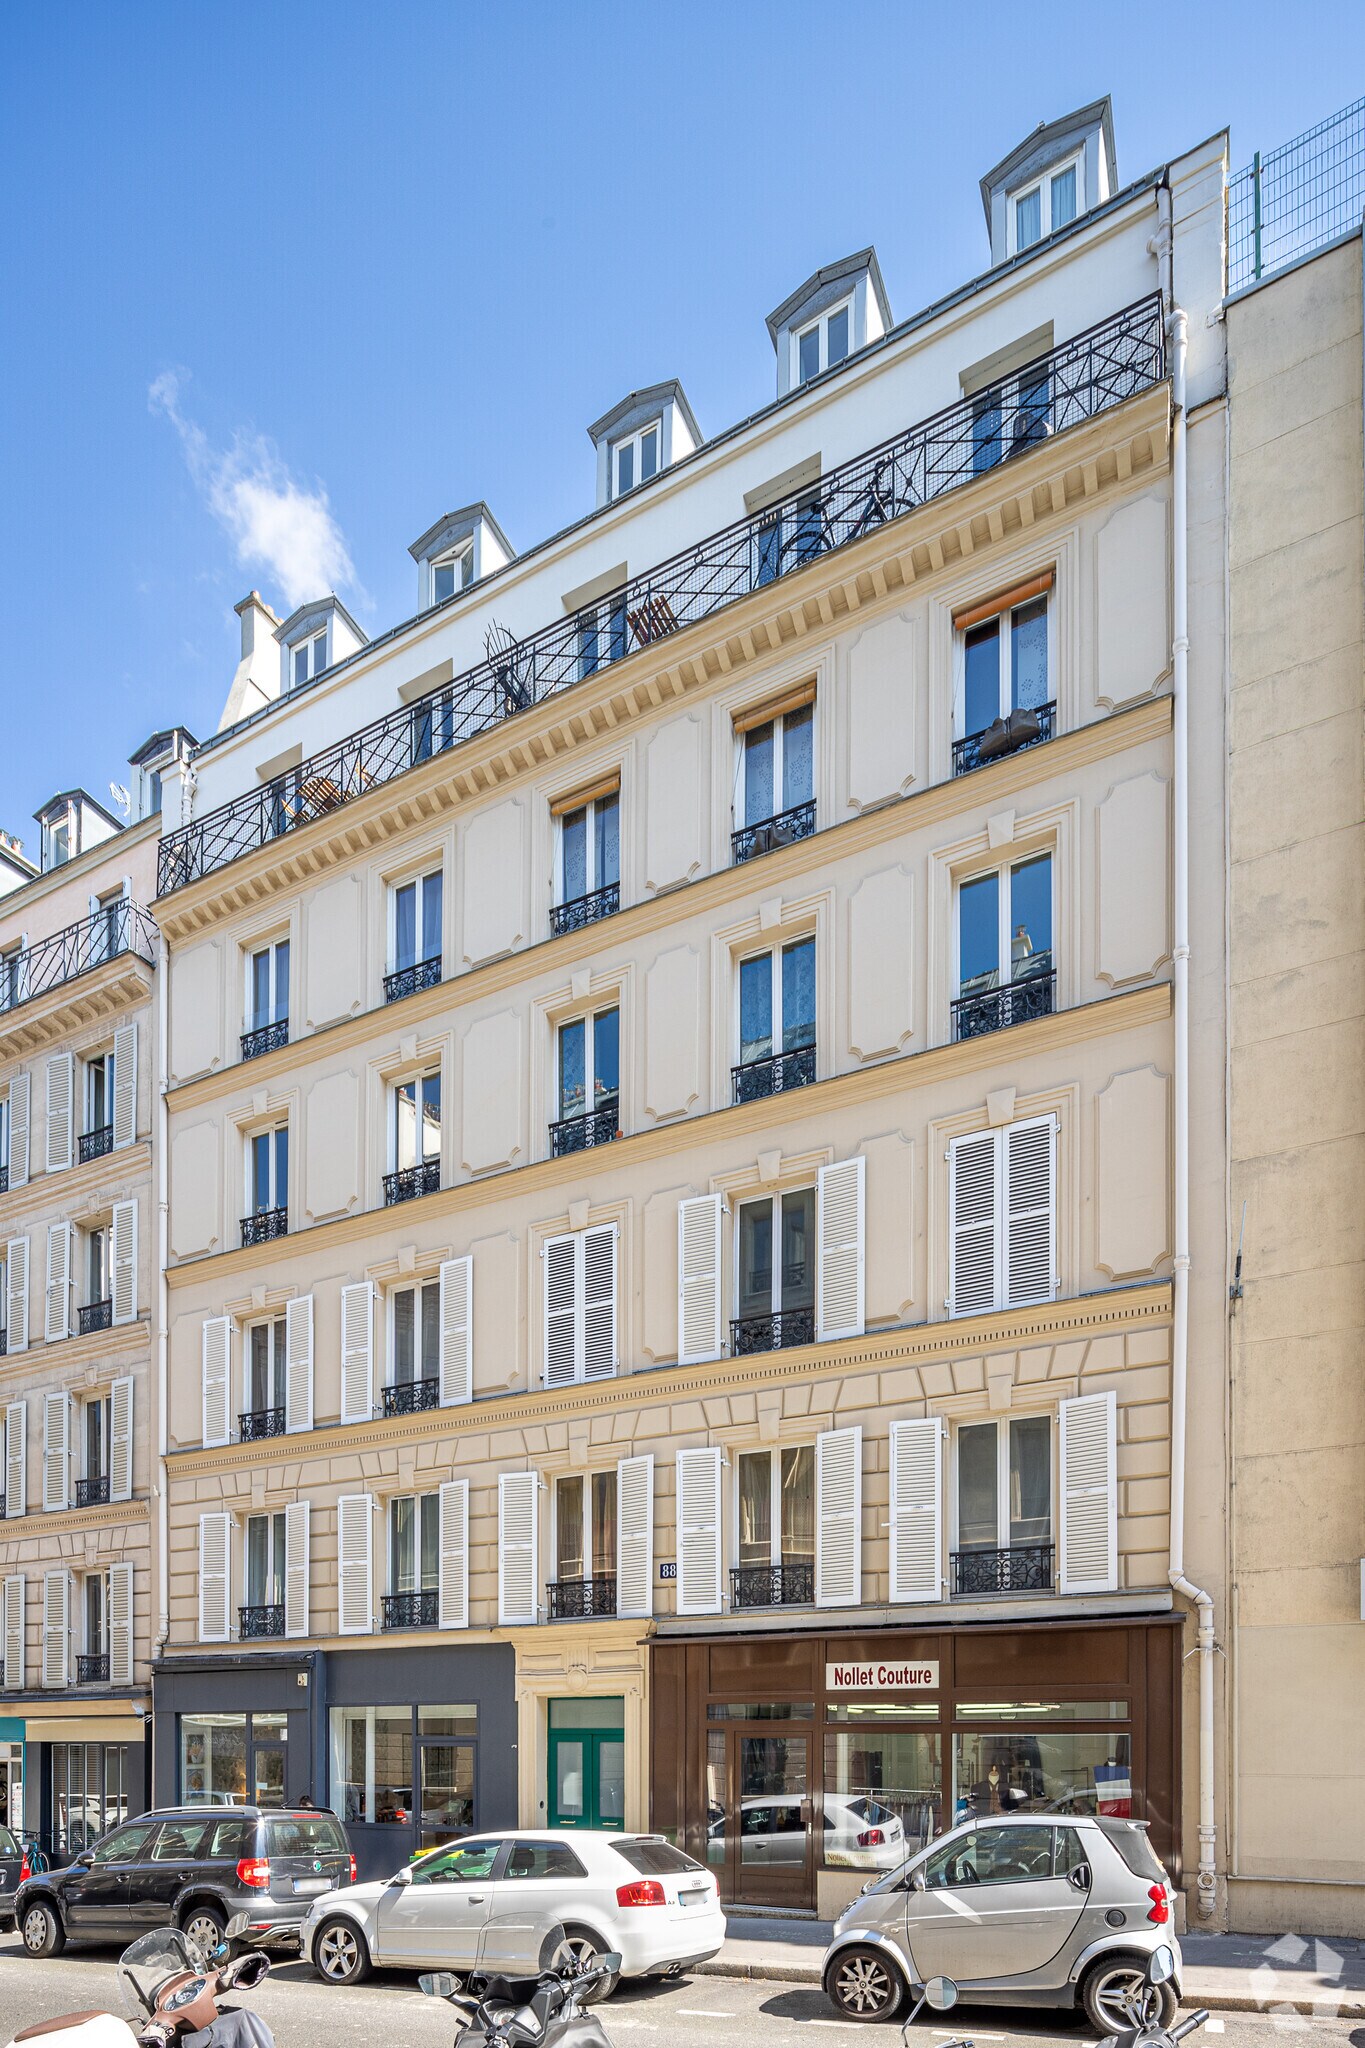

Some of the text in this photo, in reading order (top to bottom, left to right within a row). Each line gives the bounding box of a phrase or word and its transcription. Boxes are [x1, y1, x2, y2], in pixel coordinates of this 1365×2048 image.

[662, 1564, 676, 1577] 88
[834, 1665, 932, 1686] Nollet Couture
